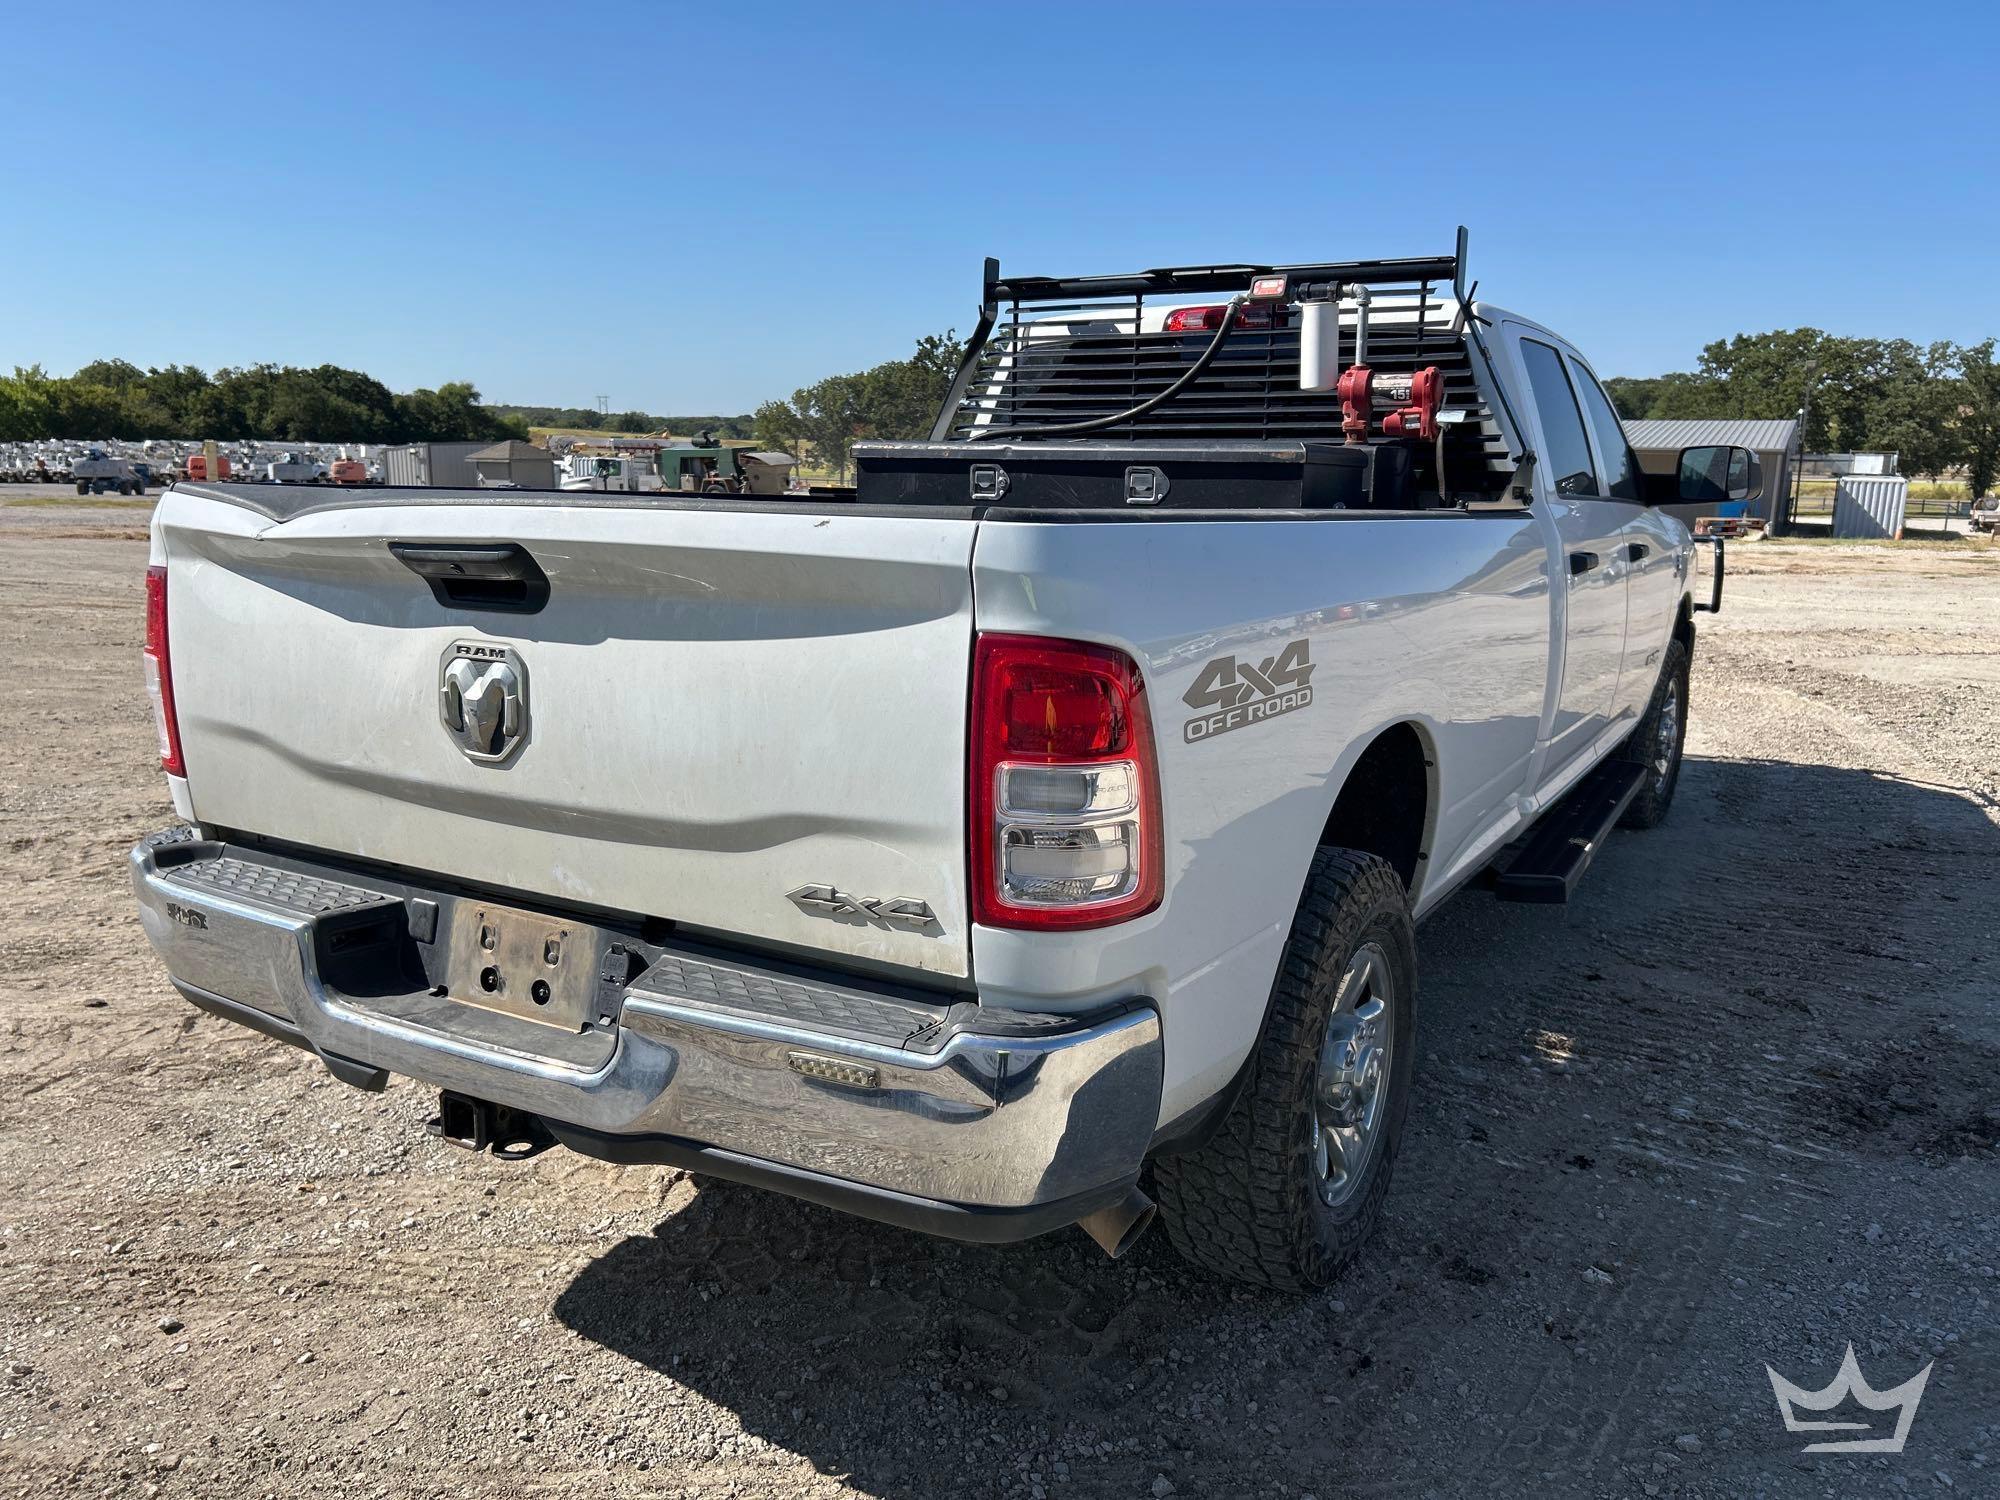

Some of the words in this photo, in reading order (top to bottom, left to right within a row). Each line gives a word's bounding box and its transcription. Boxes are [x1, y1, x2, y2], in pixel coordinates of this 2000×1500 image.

[1390, 389, 1406, 400] 15
[456, 645, 506, 659] RAM
[1186, 708, 1242, 740] OFF
[1248, 689, 1311, 721] ROAD
